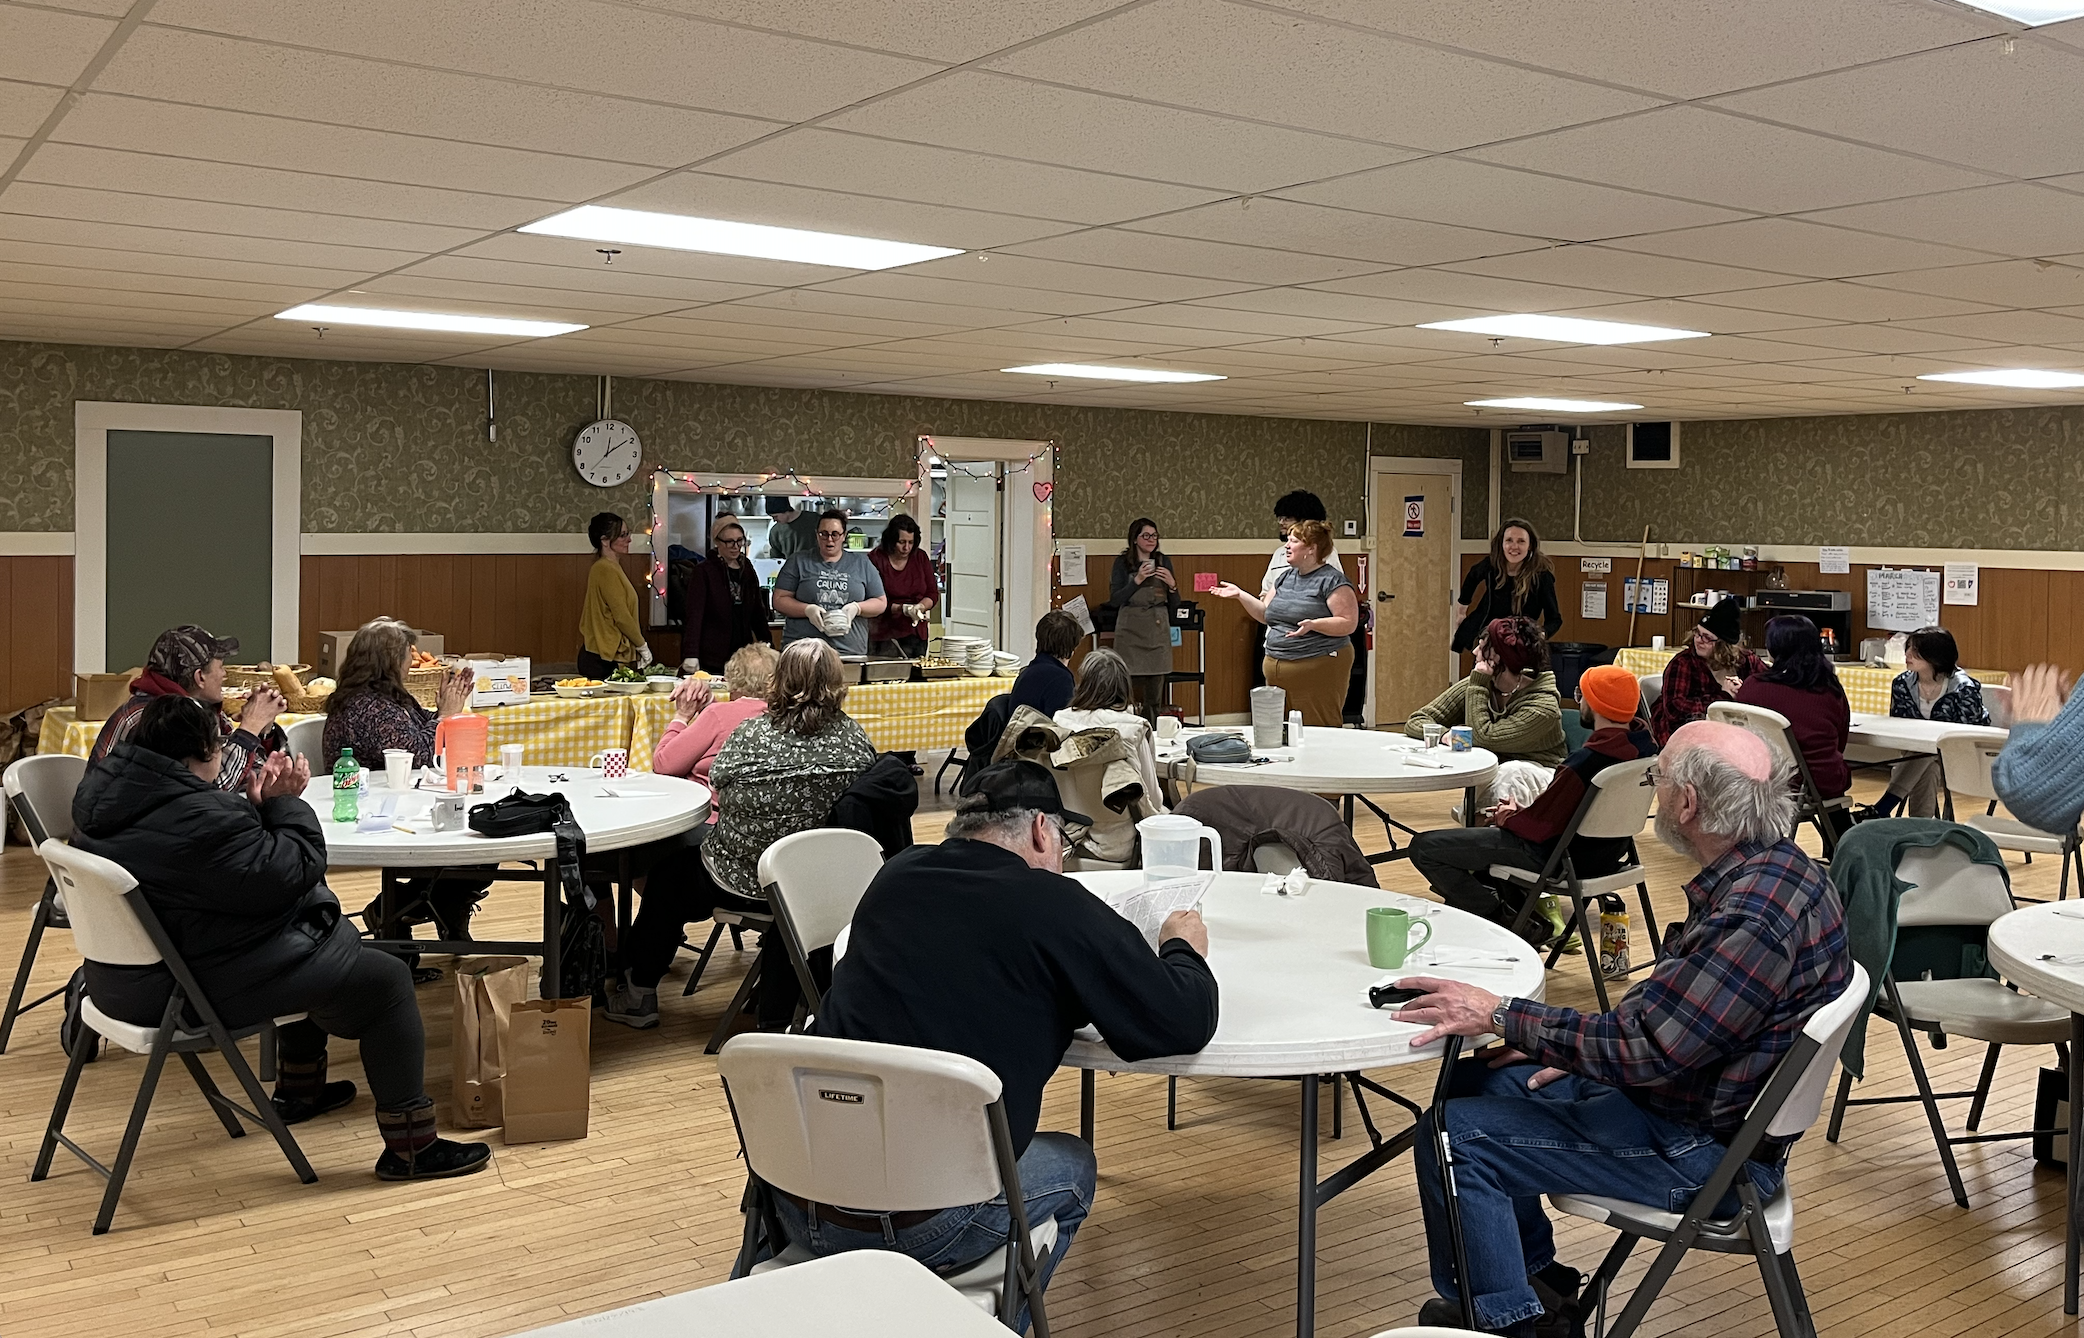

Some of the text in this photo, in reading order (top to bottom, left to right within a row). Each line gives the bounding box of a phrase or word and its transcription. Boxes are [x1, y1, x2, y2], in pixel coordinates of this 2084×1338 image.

[1582, 560, 1609, 570] Recycle
[816, 580, 848, 590] CALLING
[824, 1092, 858, 1101] LIFETIME
